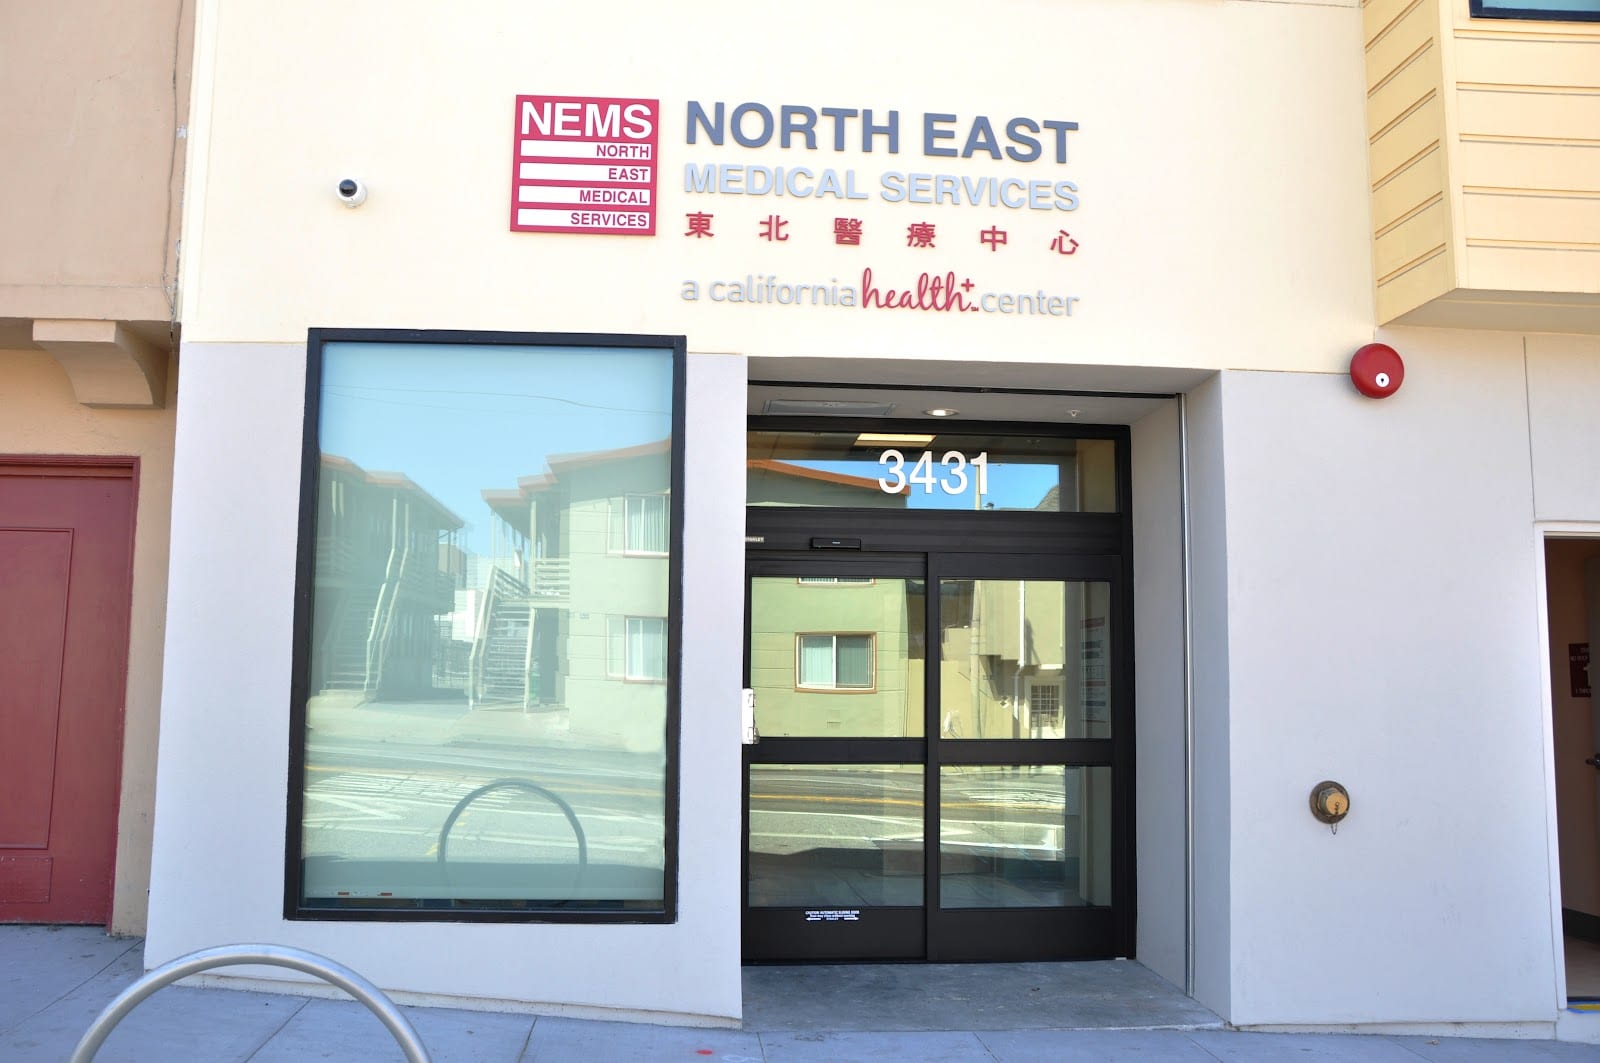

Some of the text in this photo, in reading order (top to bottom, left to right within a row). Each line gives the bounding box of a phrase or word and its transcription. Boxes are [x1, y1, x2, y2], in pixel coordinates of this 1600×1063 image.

[521, 101, 652, 139] NEMS
[686, 100, 1079, 164] NORTH EAST
[596, 144, 649, 158] NORTH
[608, 167, 649, 181] EAST
[685, 163, 1080, 211] MEDICAL SERVICES
[579, 189, 648, 204] MEDICAL
[570, 212, 647, 227] SERVICES
[684, 211, 1080, 255] 東北醫療中心
[681, 279, 700, 300] a
[709, 273, 857, 307] california
[980, 289, 1080, 316] center
[878, 449, 988, 495] 3431
